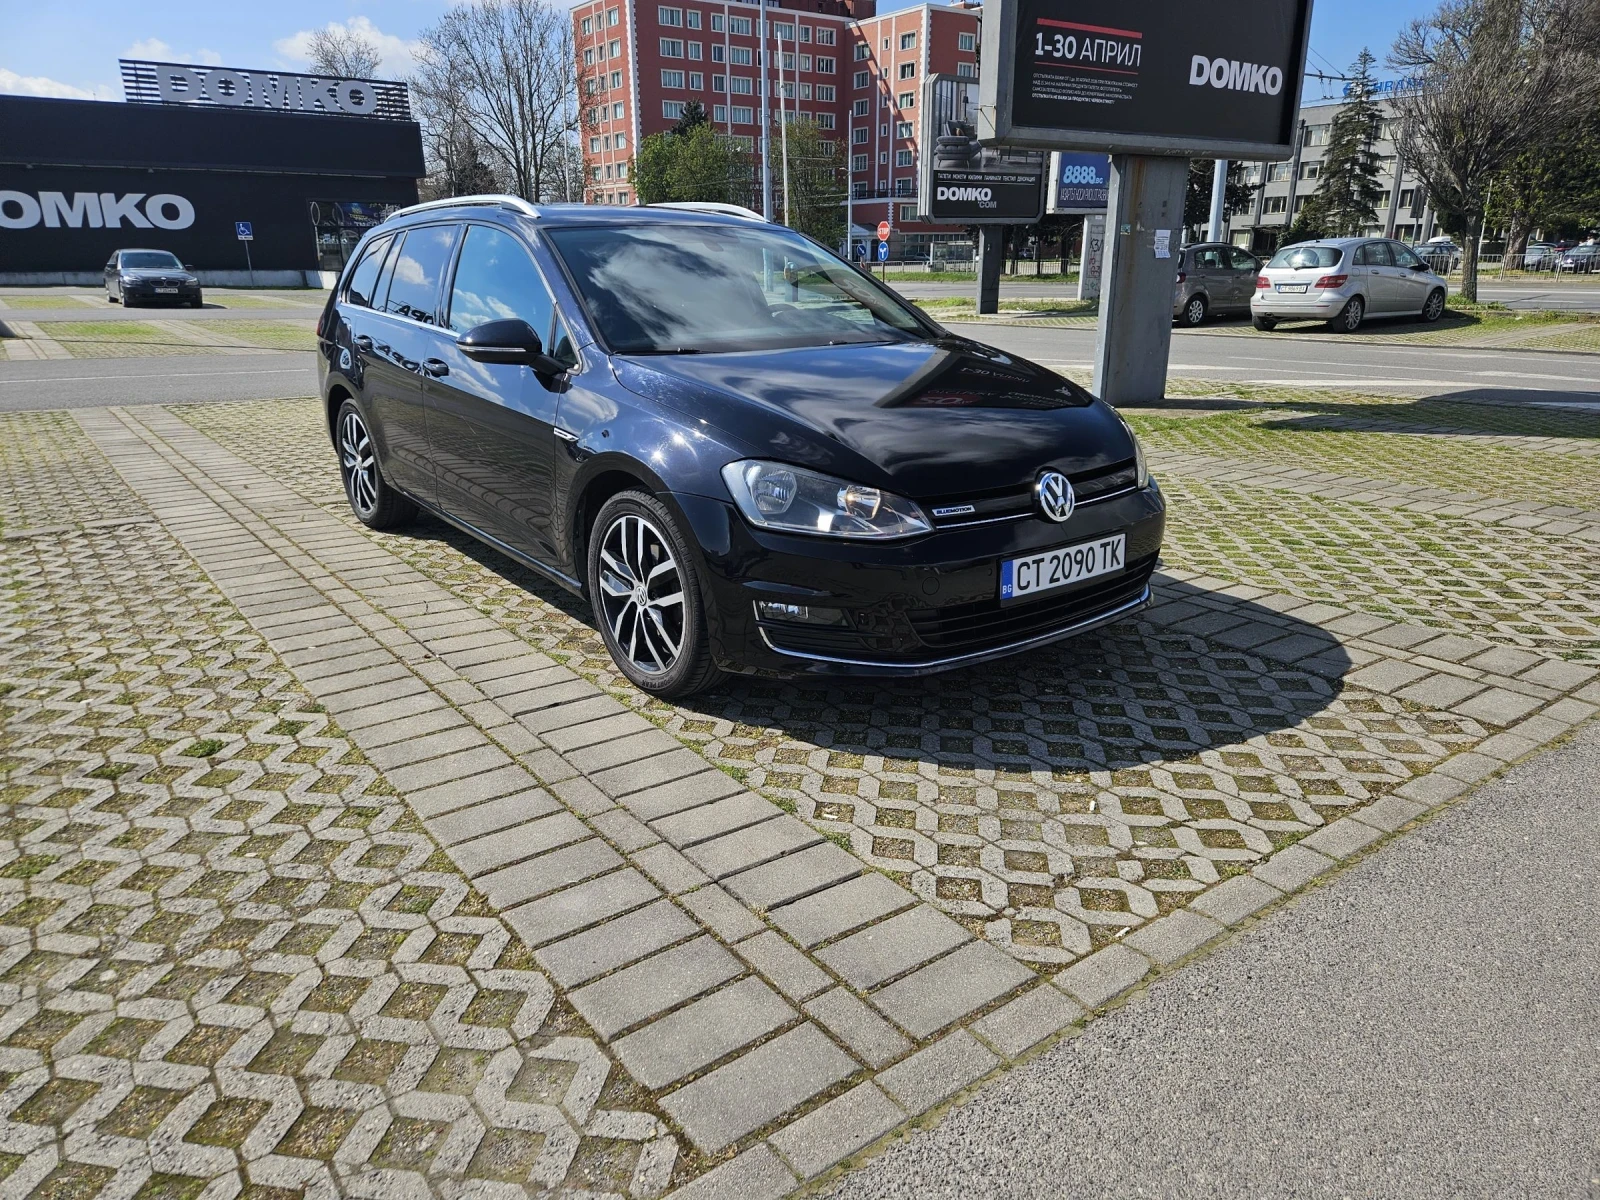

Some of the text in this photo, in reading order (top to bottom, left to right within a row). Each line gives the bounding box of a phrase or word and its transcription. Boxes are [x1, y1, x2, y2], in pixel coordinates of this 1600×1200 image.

[1035, 32, 1142, 67] 1-30 АПРИЛ
[155, 65, 378, 115] DOMKO
[1189, 54, 1283, 96] DOMKO
[937, 187, 992, 201] DOMKO
[1017, 538, 1122, 591] CT 2090 TK
[1002, 584, 1012, 594] BG
